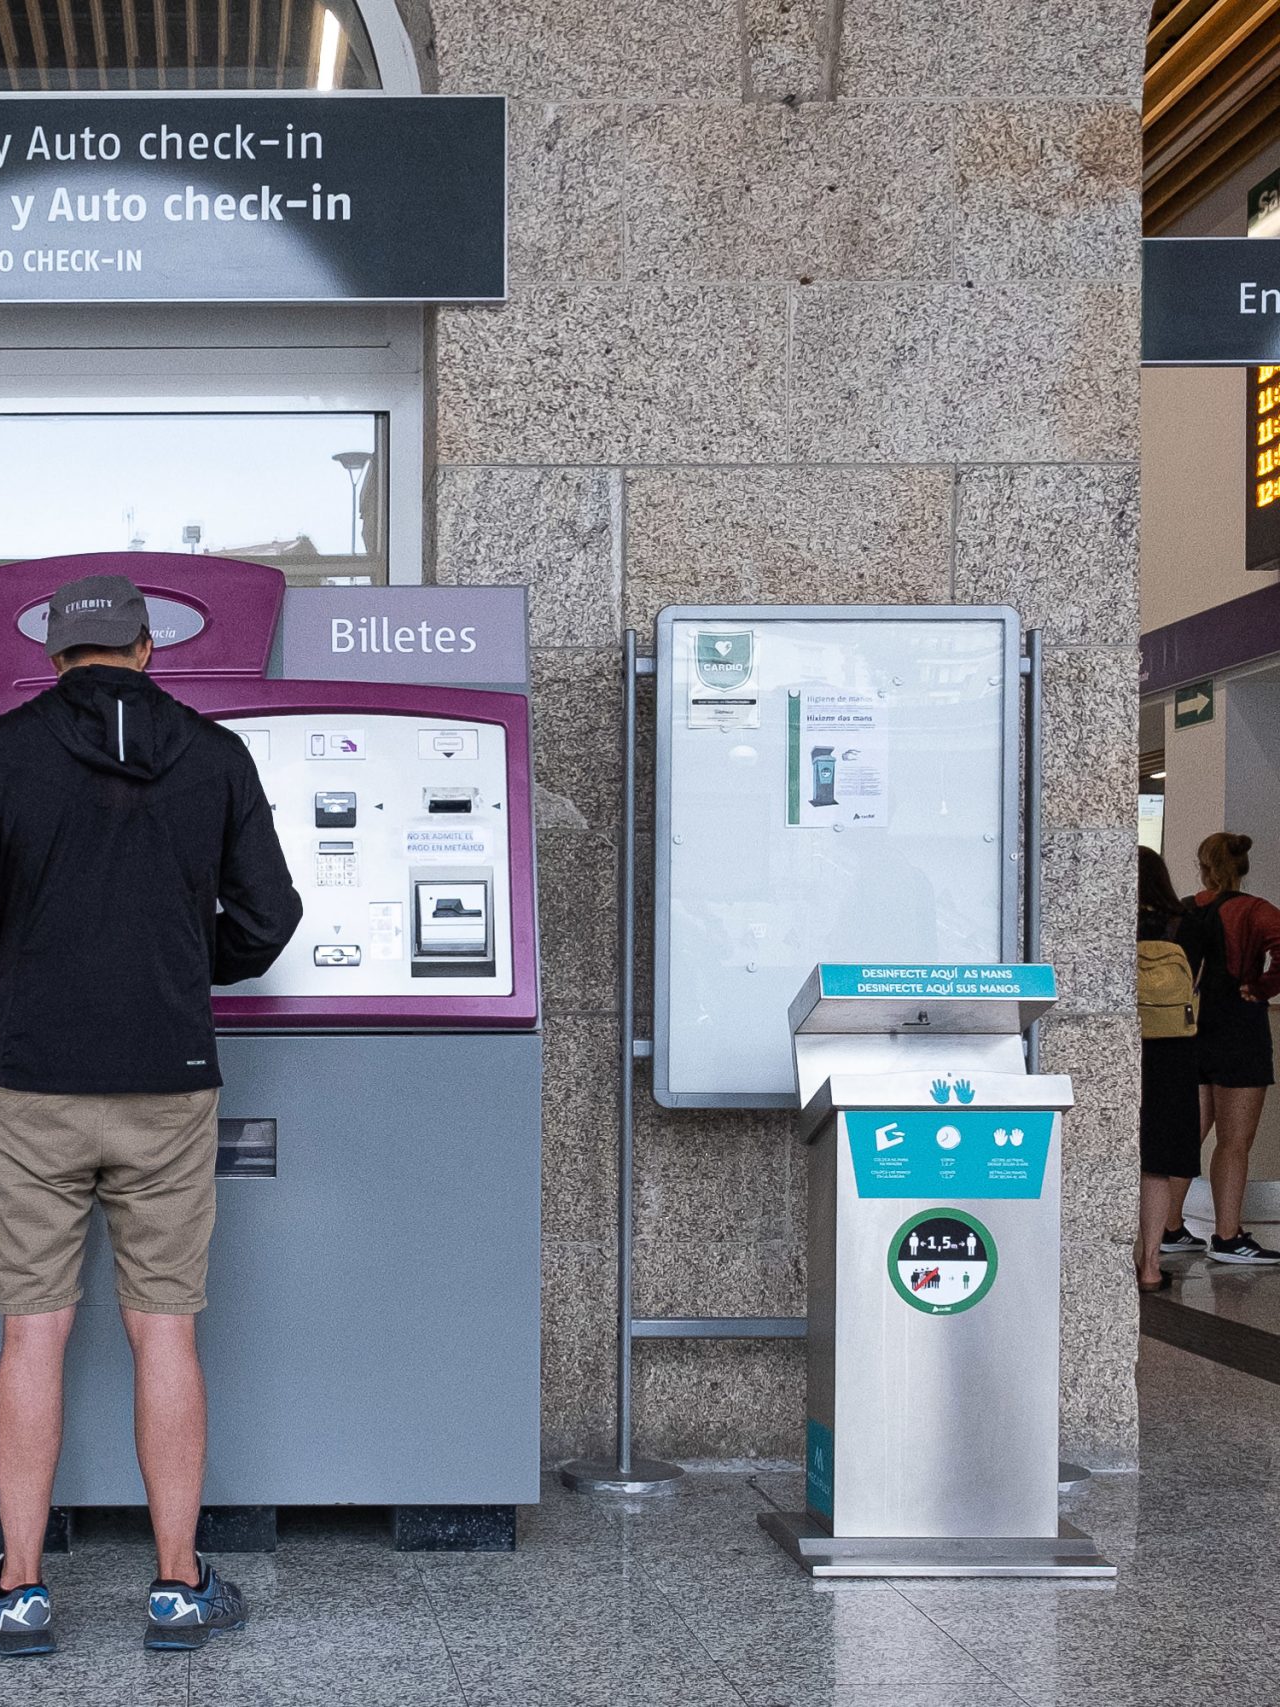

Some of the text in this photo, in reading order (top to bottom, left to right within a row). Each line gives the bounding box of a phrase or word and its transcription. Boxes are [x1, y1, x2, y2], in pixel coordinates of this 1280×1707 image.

[26, 125, 121, 161] Auto
[139, 123, 323, 160] check-in
[10, 194, 35, 231] y
[48, 187, 147, 222] Auto
[163, 183, 351, 221] check-in
[22, 249, 142, 272] CHECK-IN
[1258, 382, 1280, 414] 11:
[1258, 413, 1280, 446] 11:
[1257, 445, 1280, 477] 11:
[1257, 476, 1280, 508] 12:
[331, 616, 477, 653] Billetes
[703, 663, 743, 672] CARDIO
[857, 981, 1021, 995] DESINFECTE AQUÍ SUS MANOS
[862, 966, 1013, 981] DESINFECTE AQUÍ AS MANS
